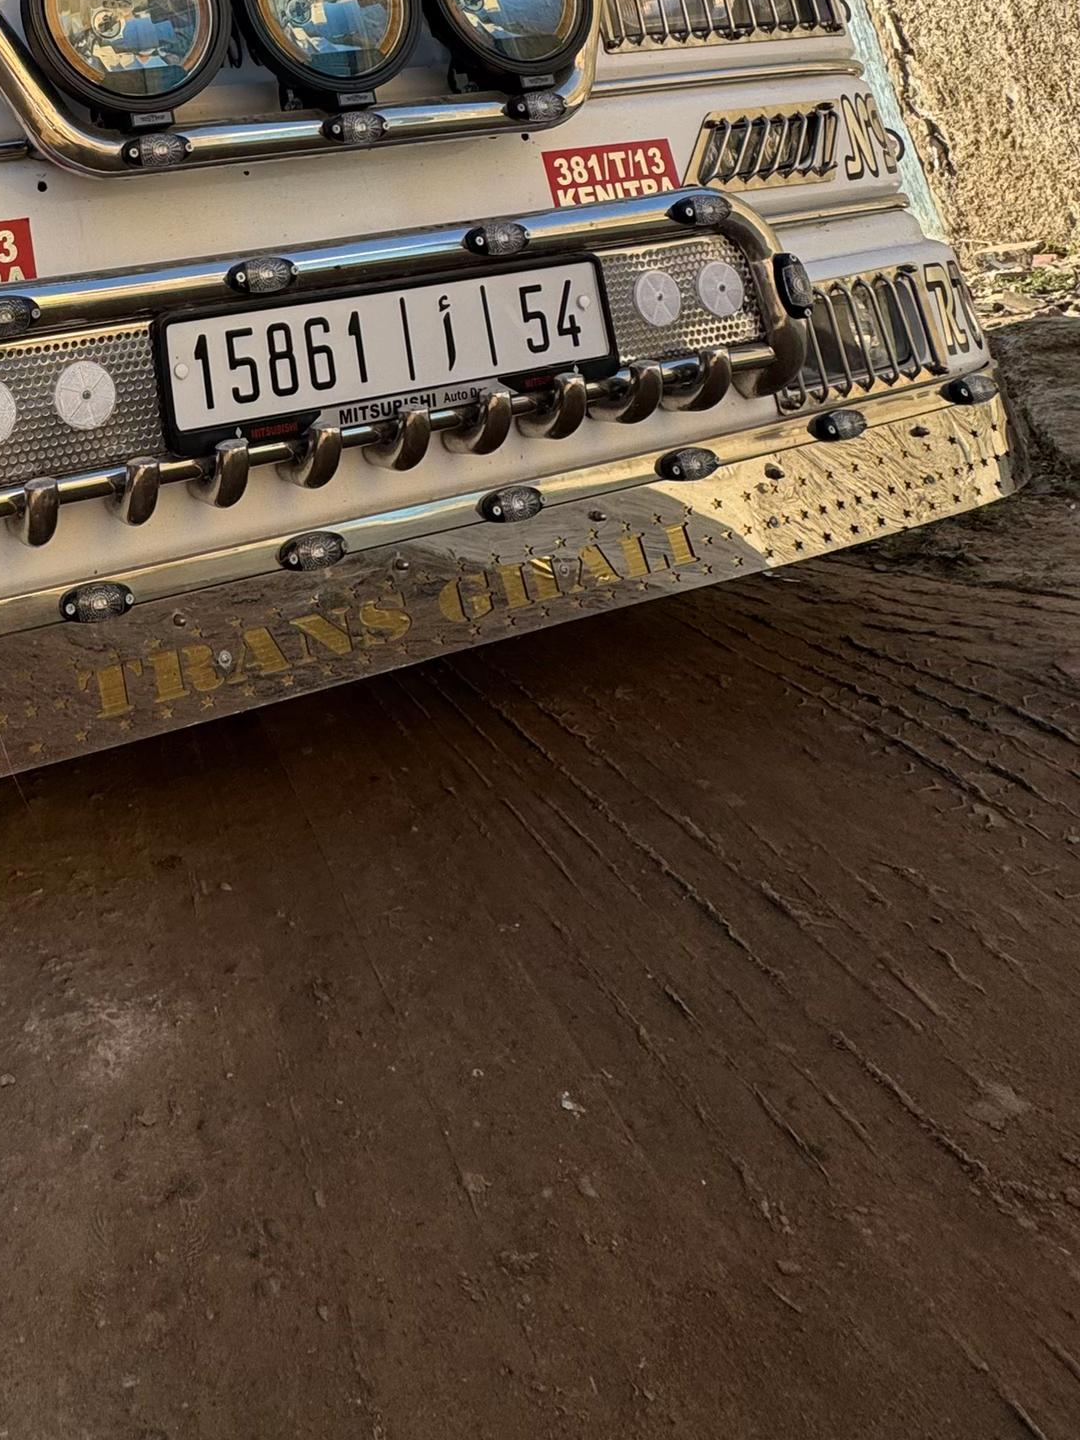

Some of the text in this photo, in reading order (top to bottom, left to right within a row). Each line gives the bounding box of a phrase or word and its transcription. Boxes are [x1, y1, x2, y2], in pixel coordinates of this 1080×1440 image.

[554, 147, 666, 185] 381/T/13
[193, 311, 369, 410] 15861
[519, 279, 582, 354] 54
[339, 393, 437, 425] MITSUBSHI
[444, 391, 468, 404] Auto
[77, 523, 702, 719] TRANS GHALI
